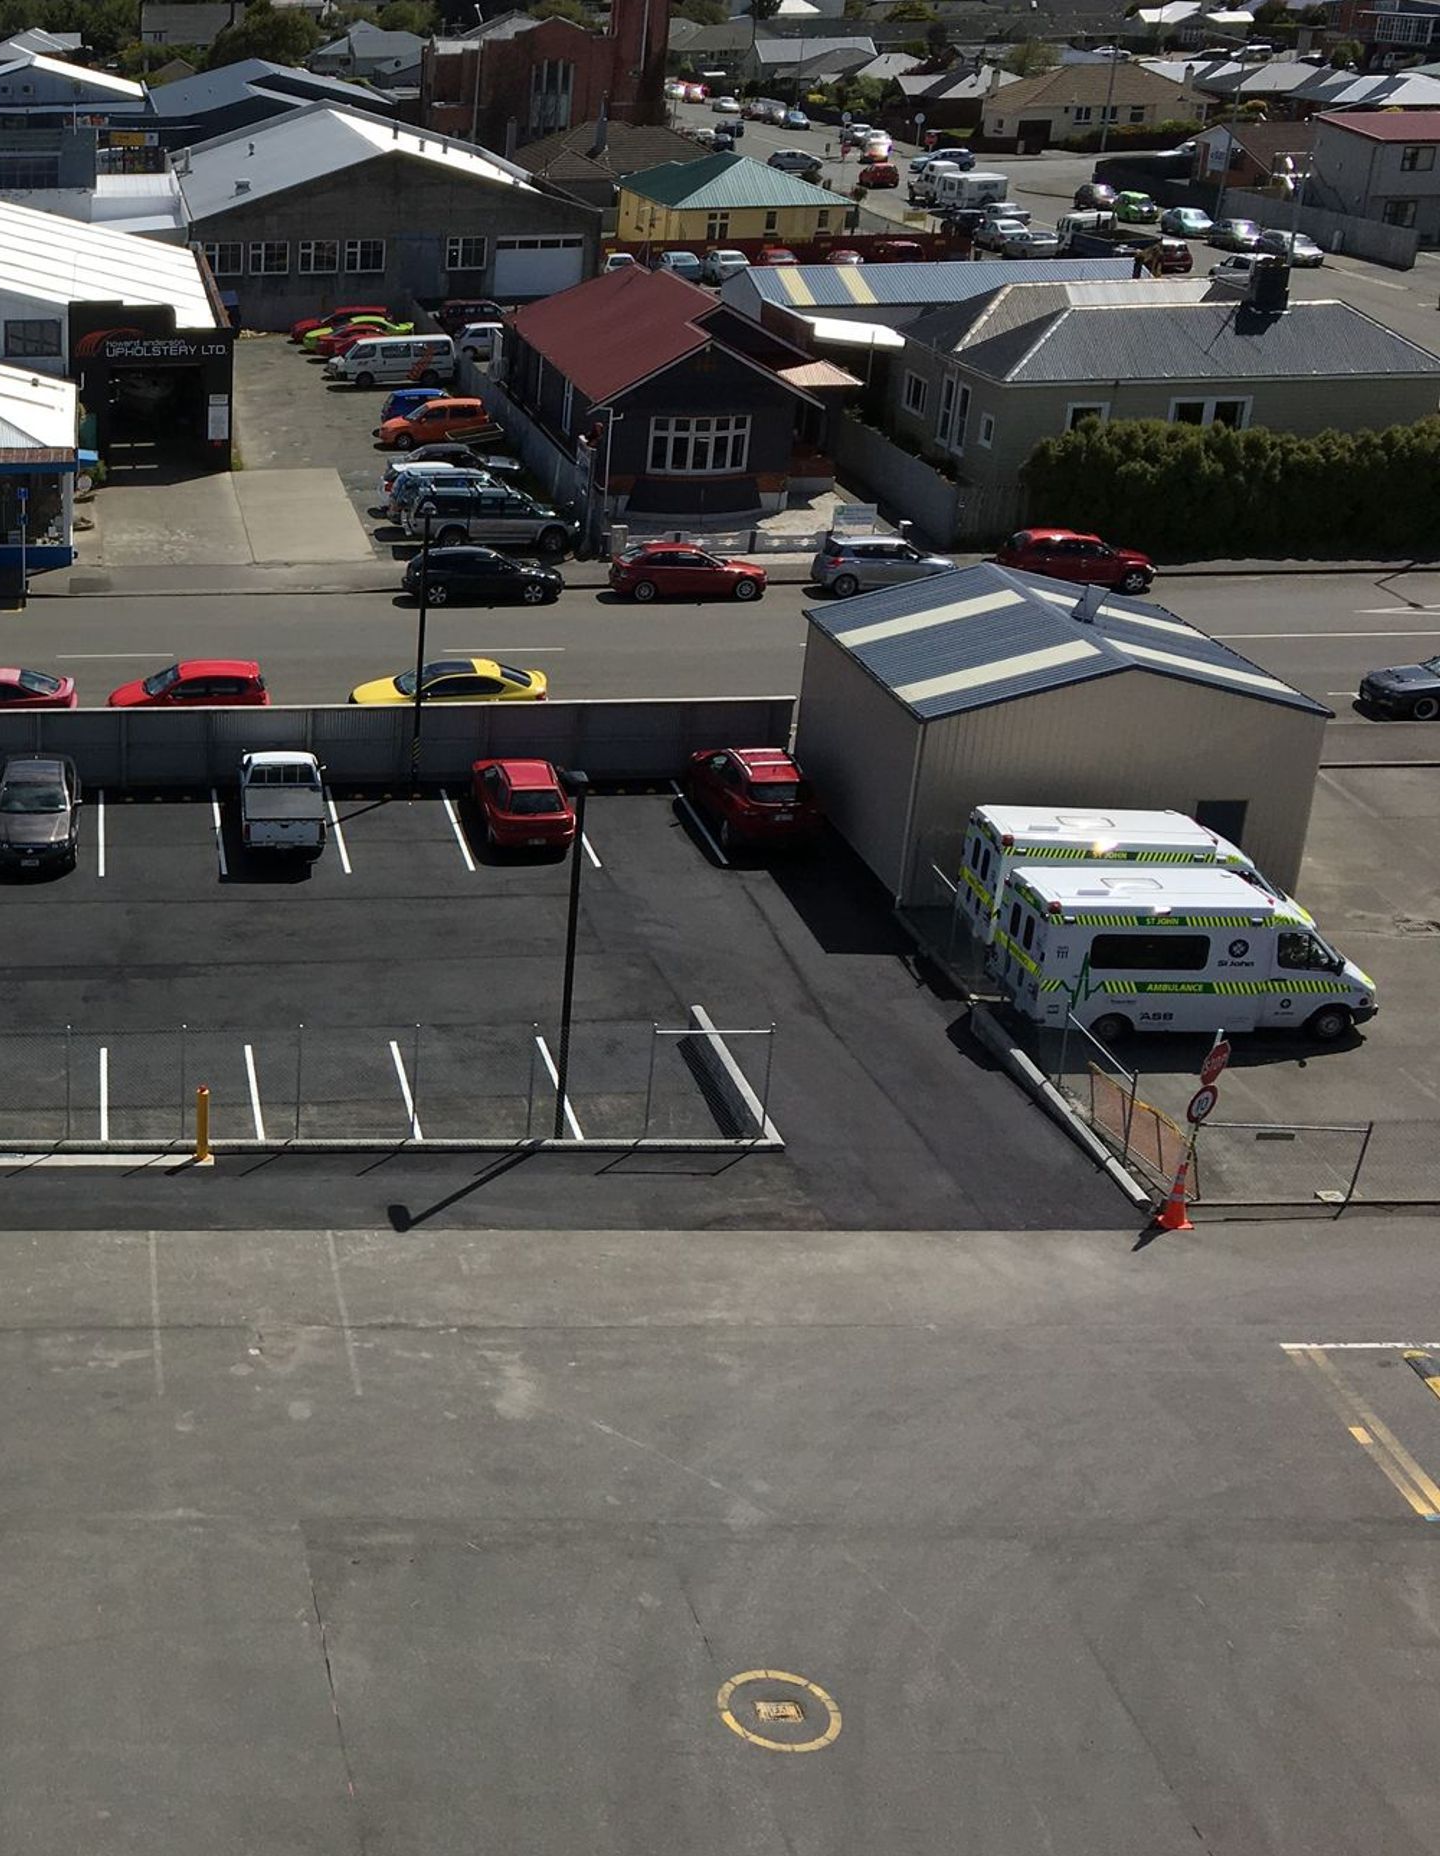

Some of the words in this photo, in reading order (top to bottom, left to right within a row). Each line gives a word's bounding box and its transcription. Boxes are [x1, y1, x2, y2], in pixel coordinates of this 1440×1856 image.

[106, 344, 197, 358] UPHOLSTERY
[1229, 959, 1254, 967] John
[1146, 983, 1203, 993] AMBULANCE
[1140, 1012, 1174, 1021] ASB
